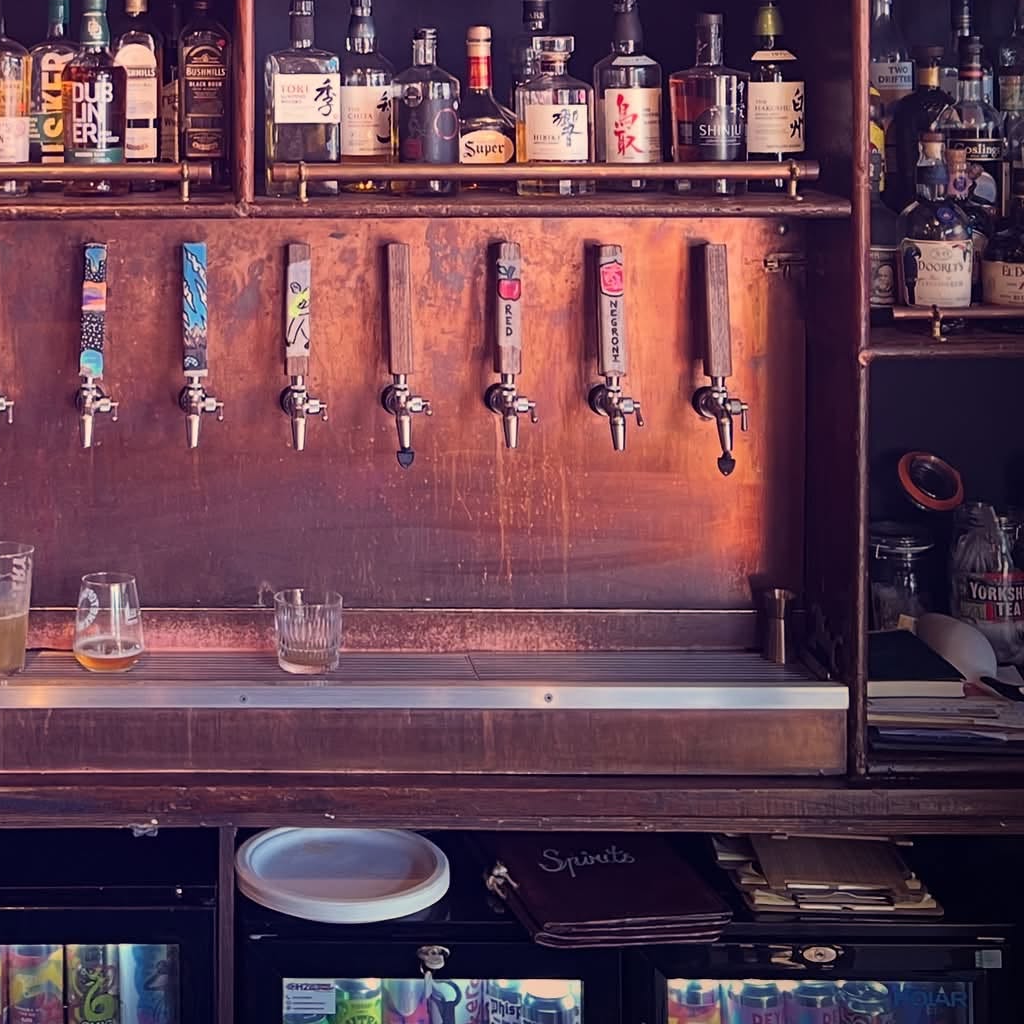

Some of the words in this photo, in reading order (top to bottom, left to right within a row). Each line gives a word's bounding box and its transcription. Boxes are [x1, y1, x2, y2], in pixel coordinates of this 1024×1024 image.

[185, 66, 226, 77] BUSHMILLS
[73, 81, 114, 103] DUB
[73, 102, 102, 123] LIN
[73, 122, 98, 144] ER
[698, 123, 742, 138] SHINJU
[463, 140, 505, 159] Super
[504, 304, 513, 337] RED
[609, 300, 621, 363] NEGRONI
[996, 602, 1022, 617] TEA
